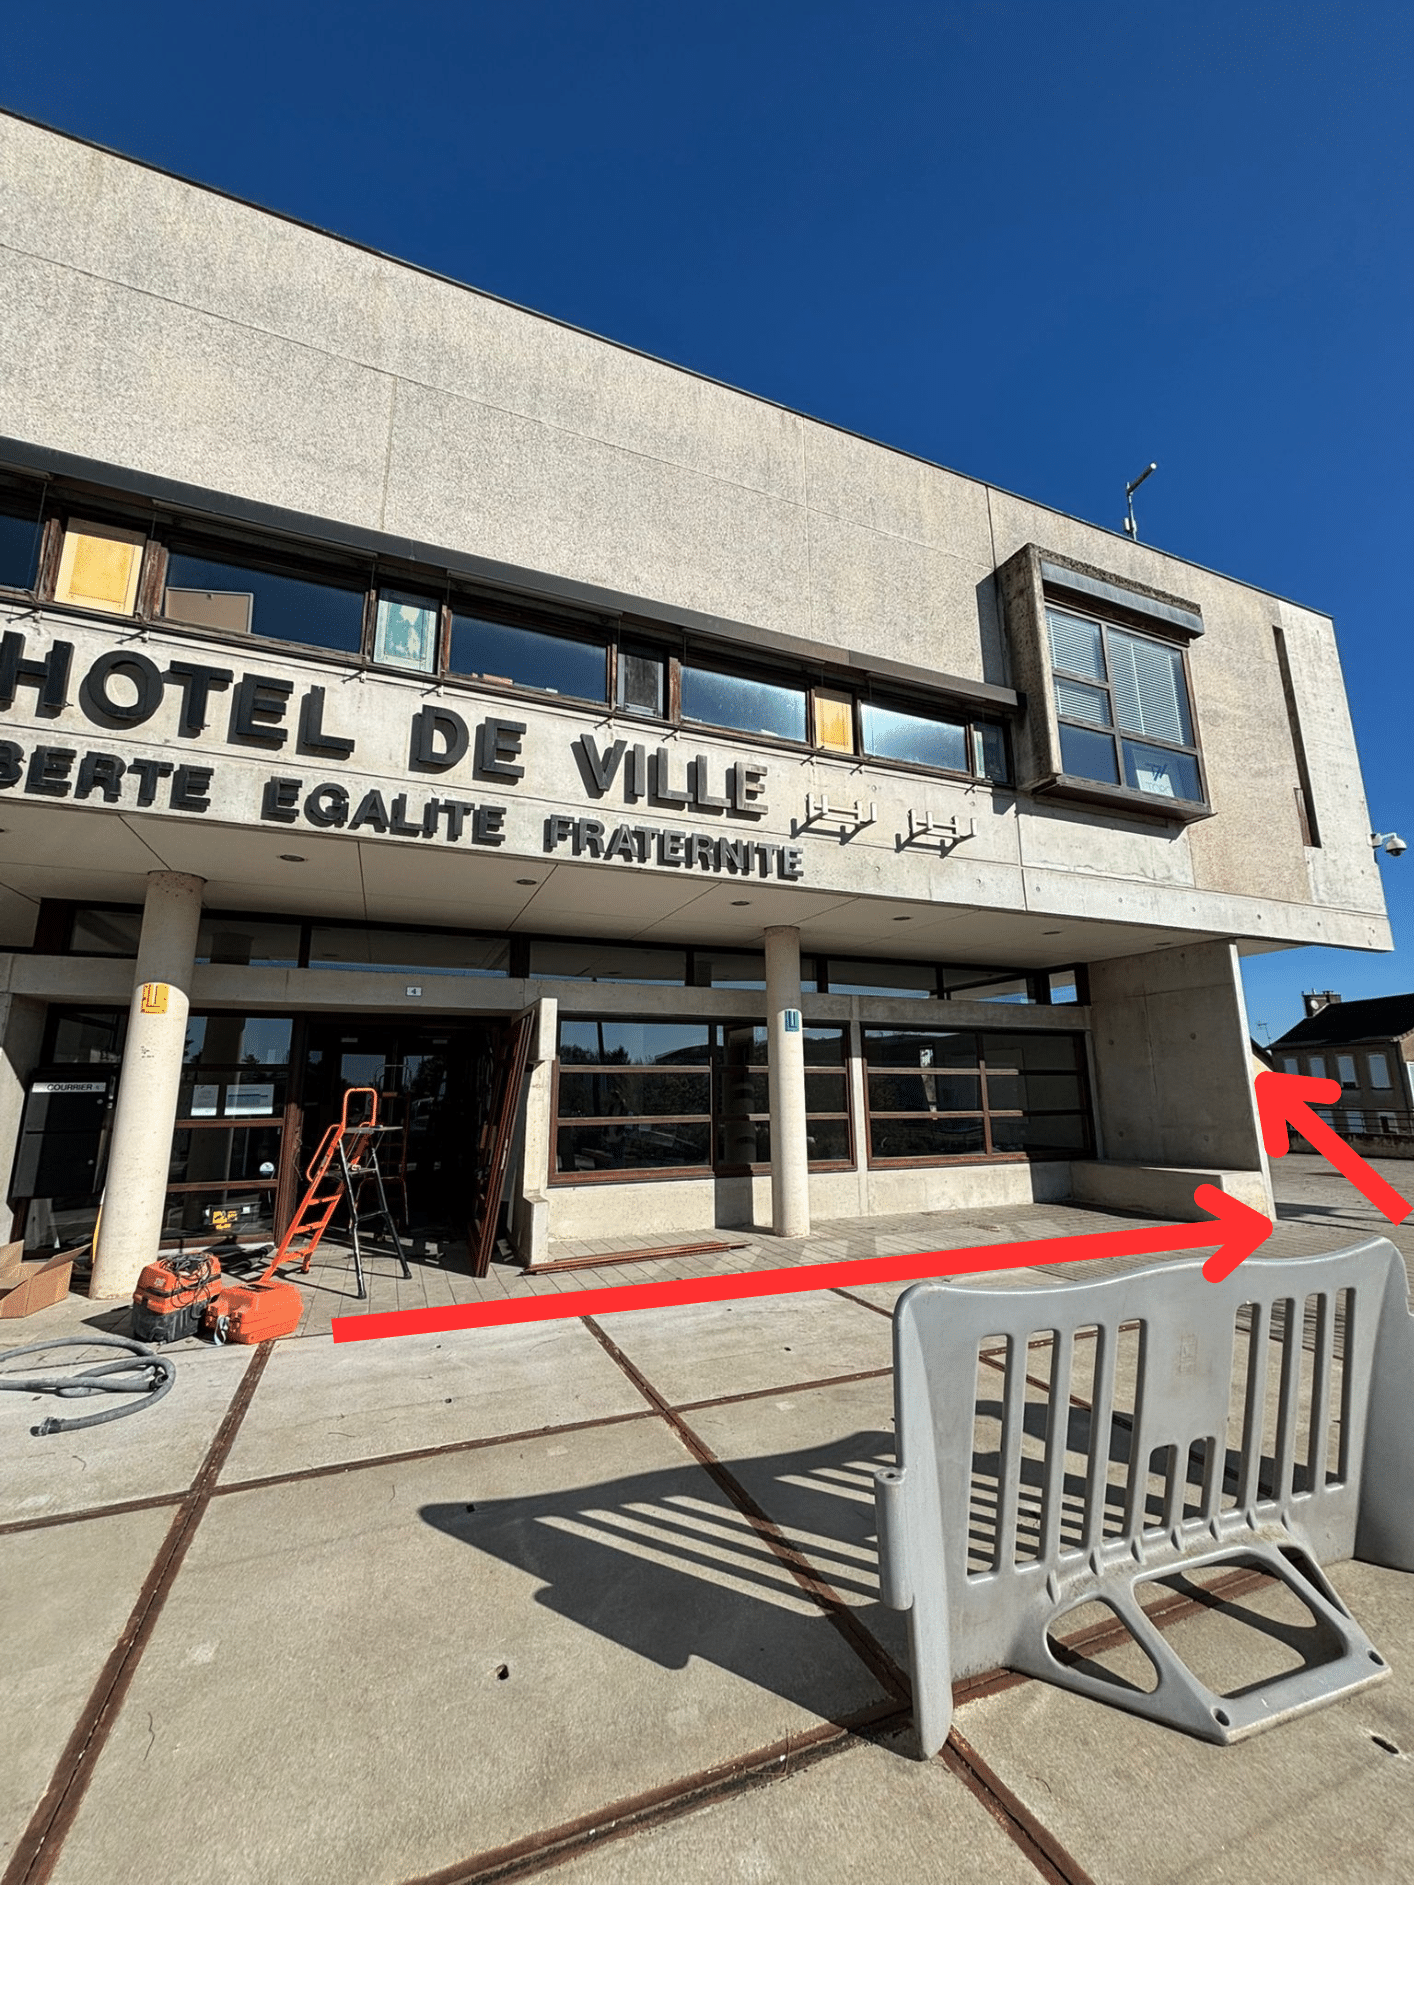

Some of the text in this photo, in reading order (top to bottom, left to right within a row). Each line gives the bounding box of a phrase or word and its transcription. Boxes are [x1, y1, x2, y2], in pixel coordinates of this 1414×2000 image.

[0, 628, 769, 816] HOTEL DE VILLE
[264, 775, 507, 843] EGALITE
[548, 814, 804, 878] FRATERNITE
[46, 1083, 93, 1091] COURRIER
